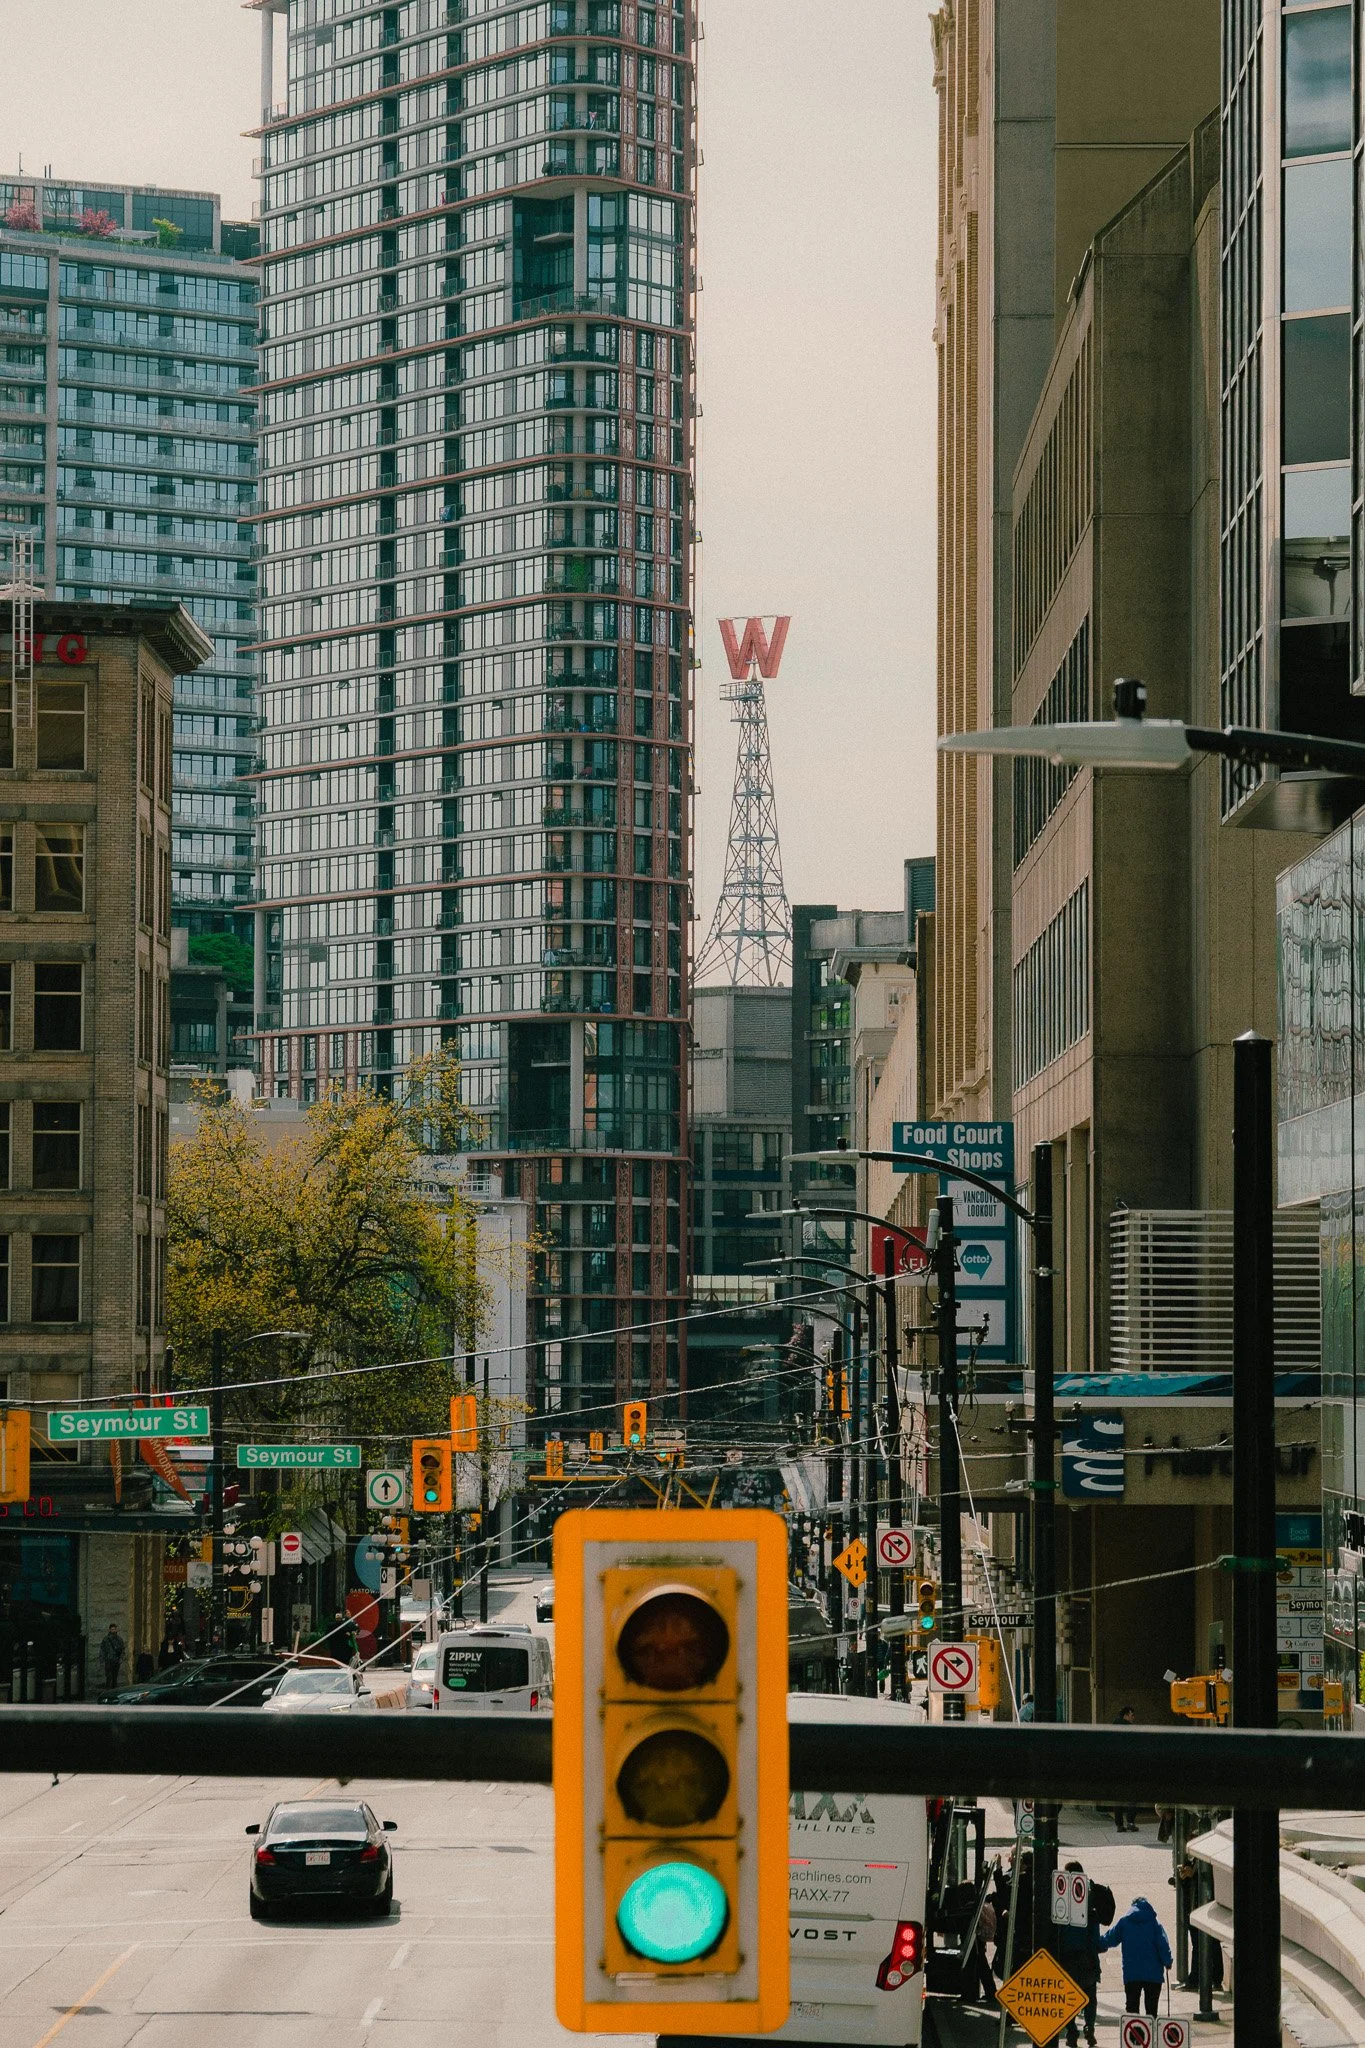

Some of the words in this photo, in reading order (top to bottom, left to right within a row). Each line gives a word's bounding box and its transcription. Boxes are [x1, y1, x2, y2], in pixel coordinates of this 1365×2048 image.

[718, 616, 791, 679] W
[903, 1124, 947, 1144] Food
[953, 1124, 1003, 1144] Court
[947, 1148, 1003, 1171] Shops
[967, 1204, 998, 1217] LOOKOUT
[962, 1254, 990, 1264] lotto!
[60, 1414, 162, 1436] Seymour
[172, 1410, 198, 1430] St
[246, 1447, 324, 1466] Seymour
[333, 1447, 352, 1463] St
[971, 1615, 1020, 1628] Seymour
[449, 1652, 482, 1661] ZIPPLY
[789, 1887, 850, 1903] RAXX-77
[1020, 1977, 1065, 1989] TRAFFIC
[1017, 1991, 1066, 2004] PATTERN
[1018, 2006, 1065, 2018] CHANGE
